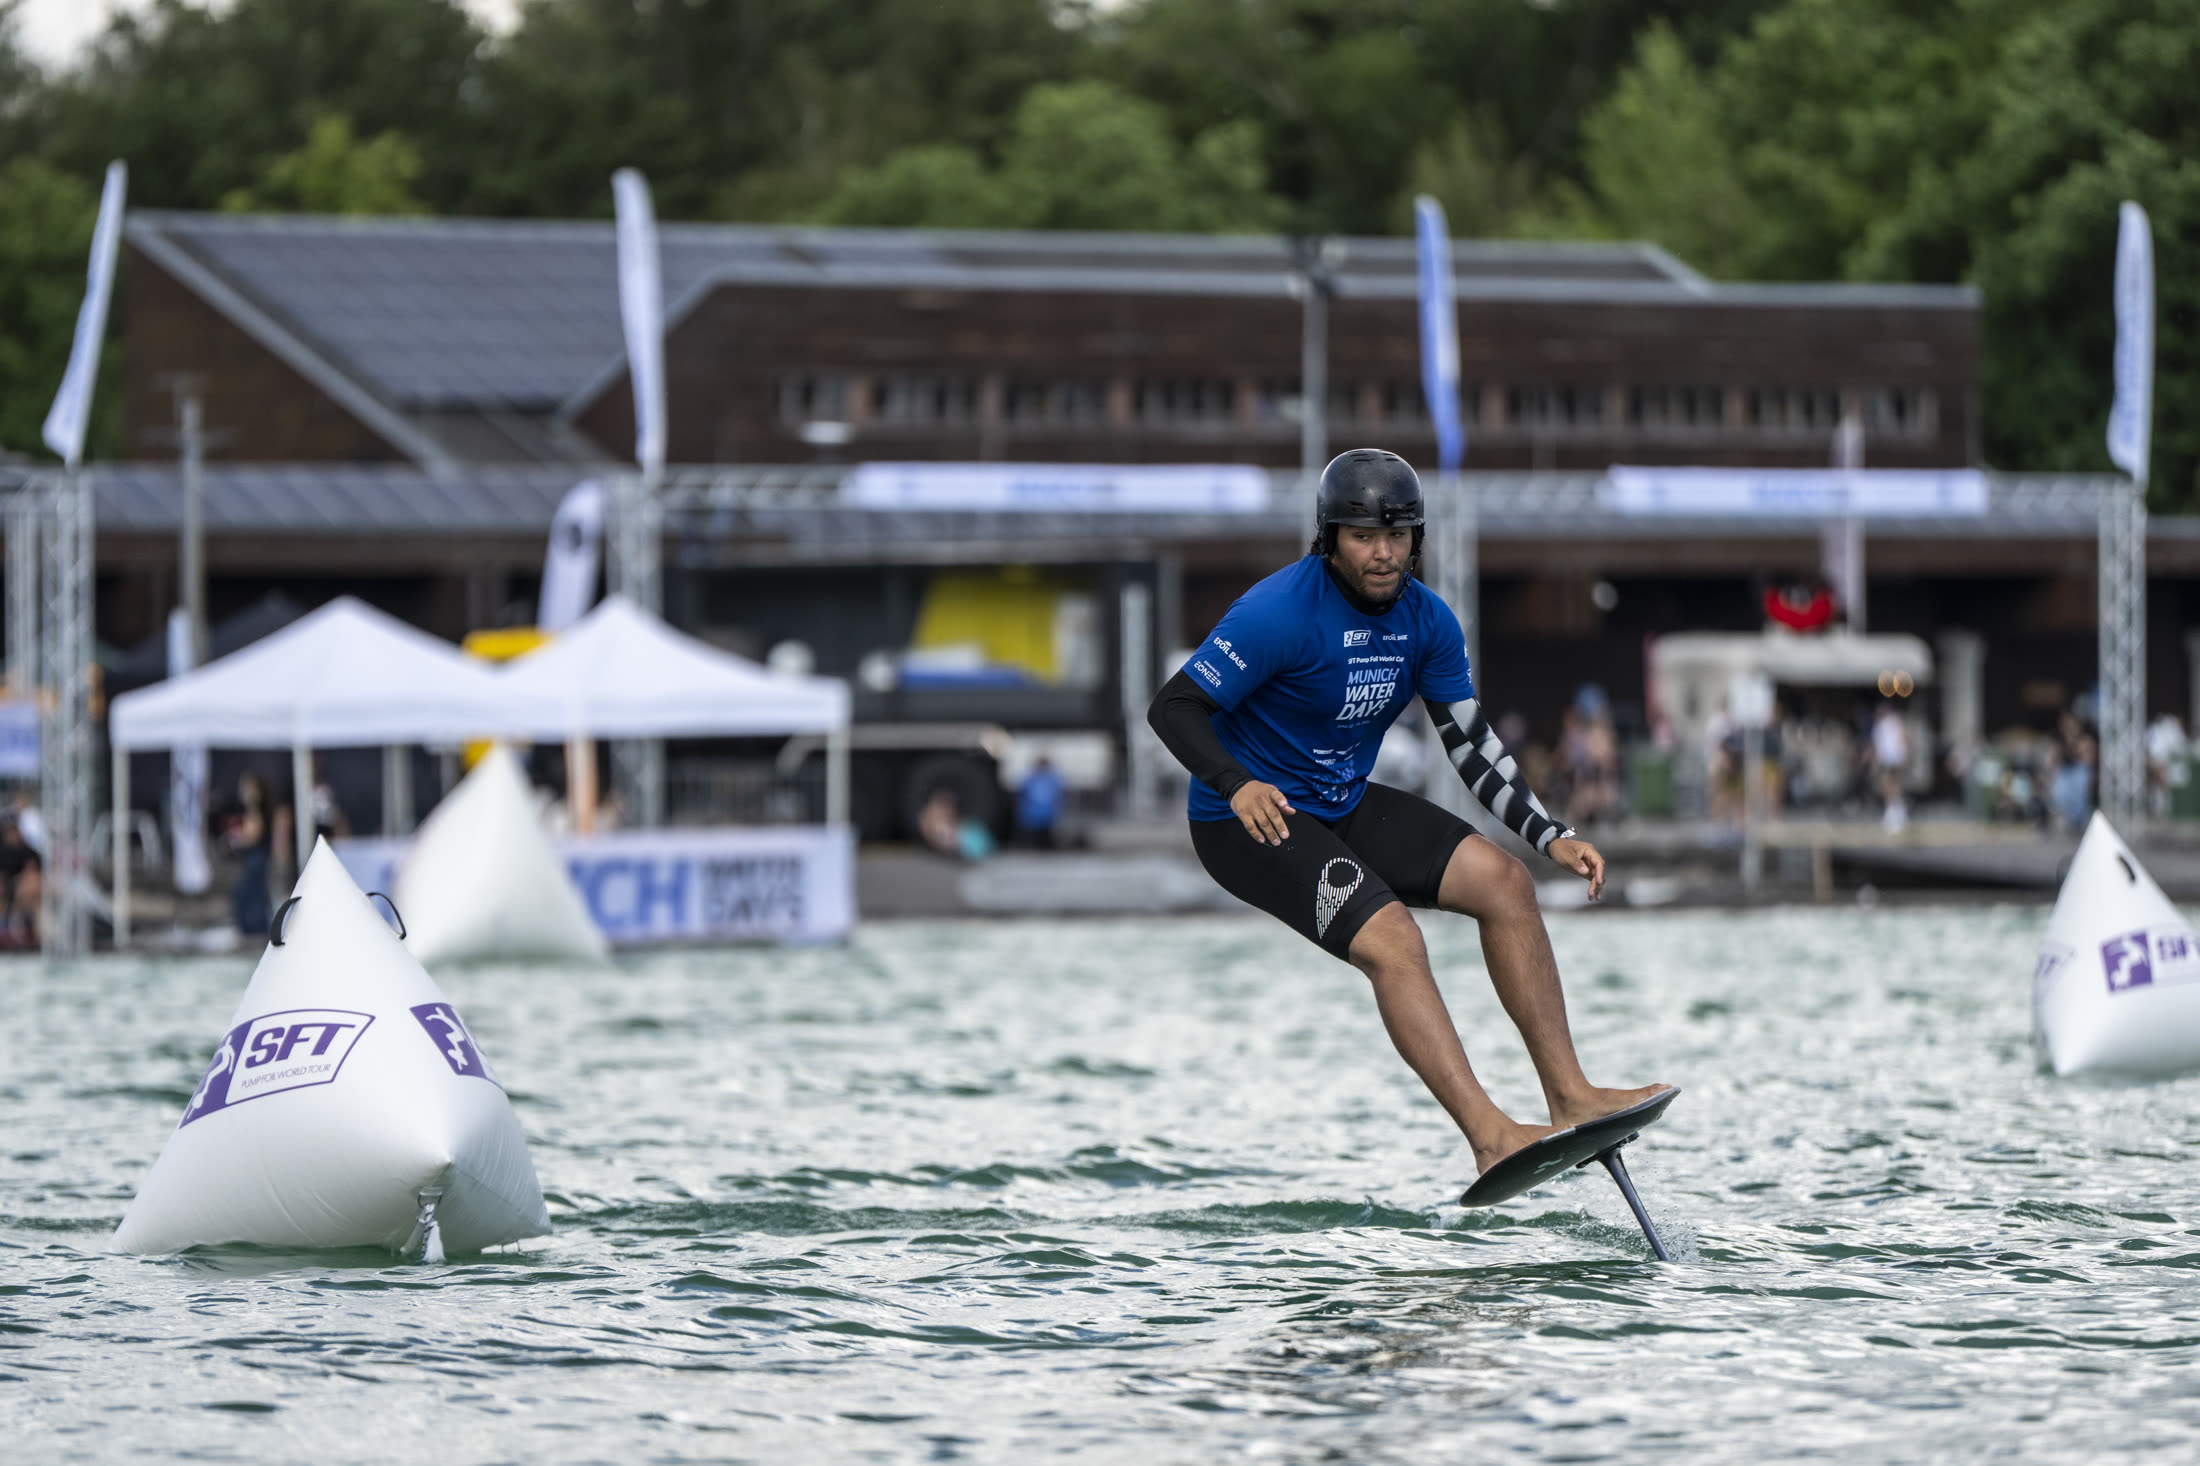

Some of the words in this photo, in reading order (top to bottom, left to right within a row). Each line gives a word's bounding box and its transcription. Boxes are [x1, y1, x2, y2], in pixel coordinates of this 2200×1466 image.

[1353, 632, 1369, 641] SFT
[1213, 636, 1231, 655] EFOIL
[1228, 651, 1247, 671] BASE
[1193, 660, 1222, 688] EONEER
[1347, 667, 1400, 685] MUNICH
[1345, 682, 1396, 703] WATER
[1334, 698, 1391, 721] DAYS
[245, 1022, 356, 1069] SFT
[277, 1066, 307, 1080] WORLD
[308, 1063, 331, 1074] TOUR
